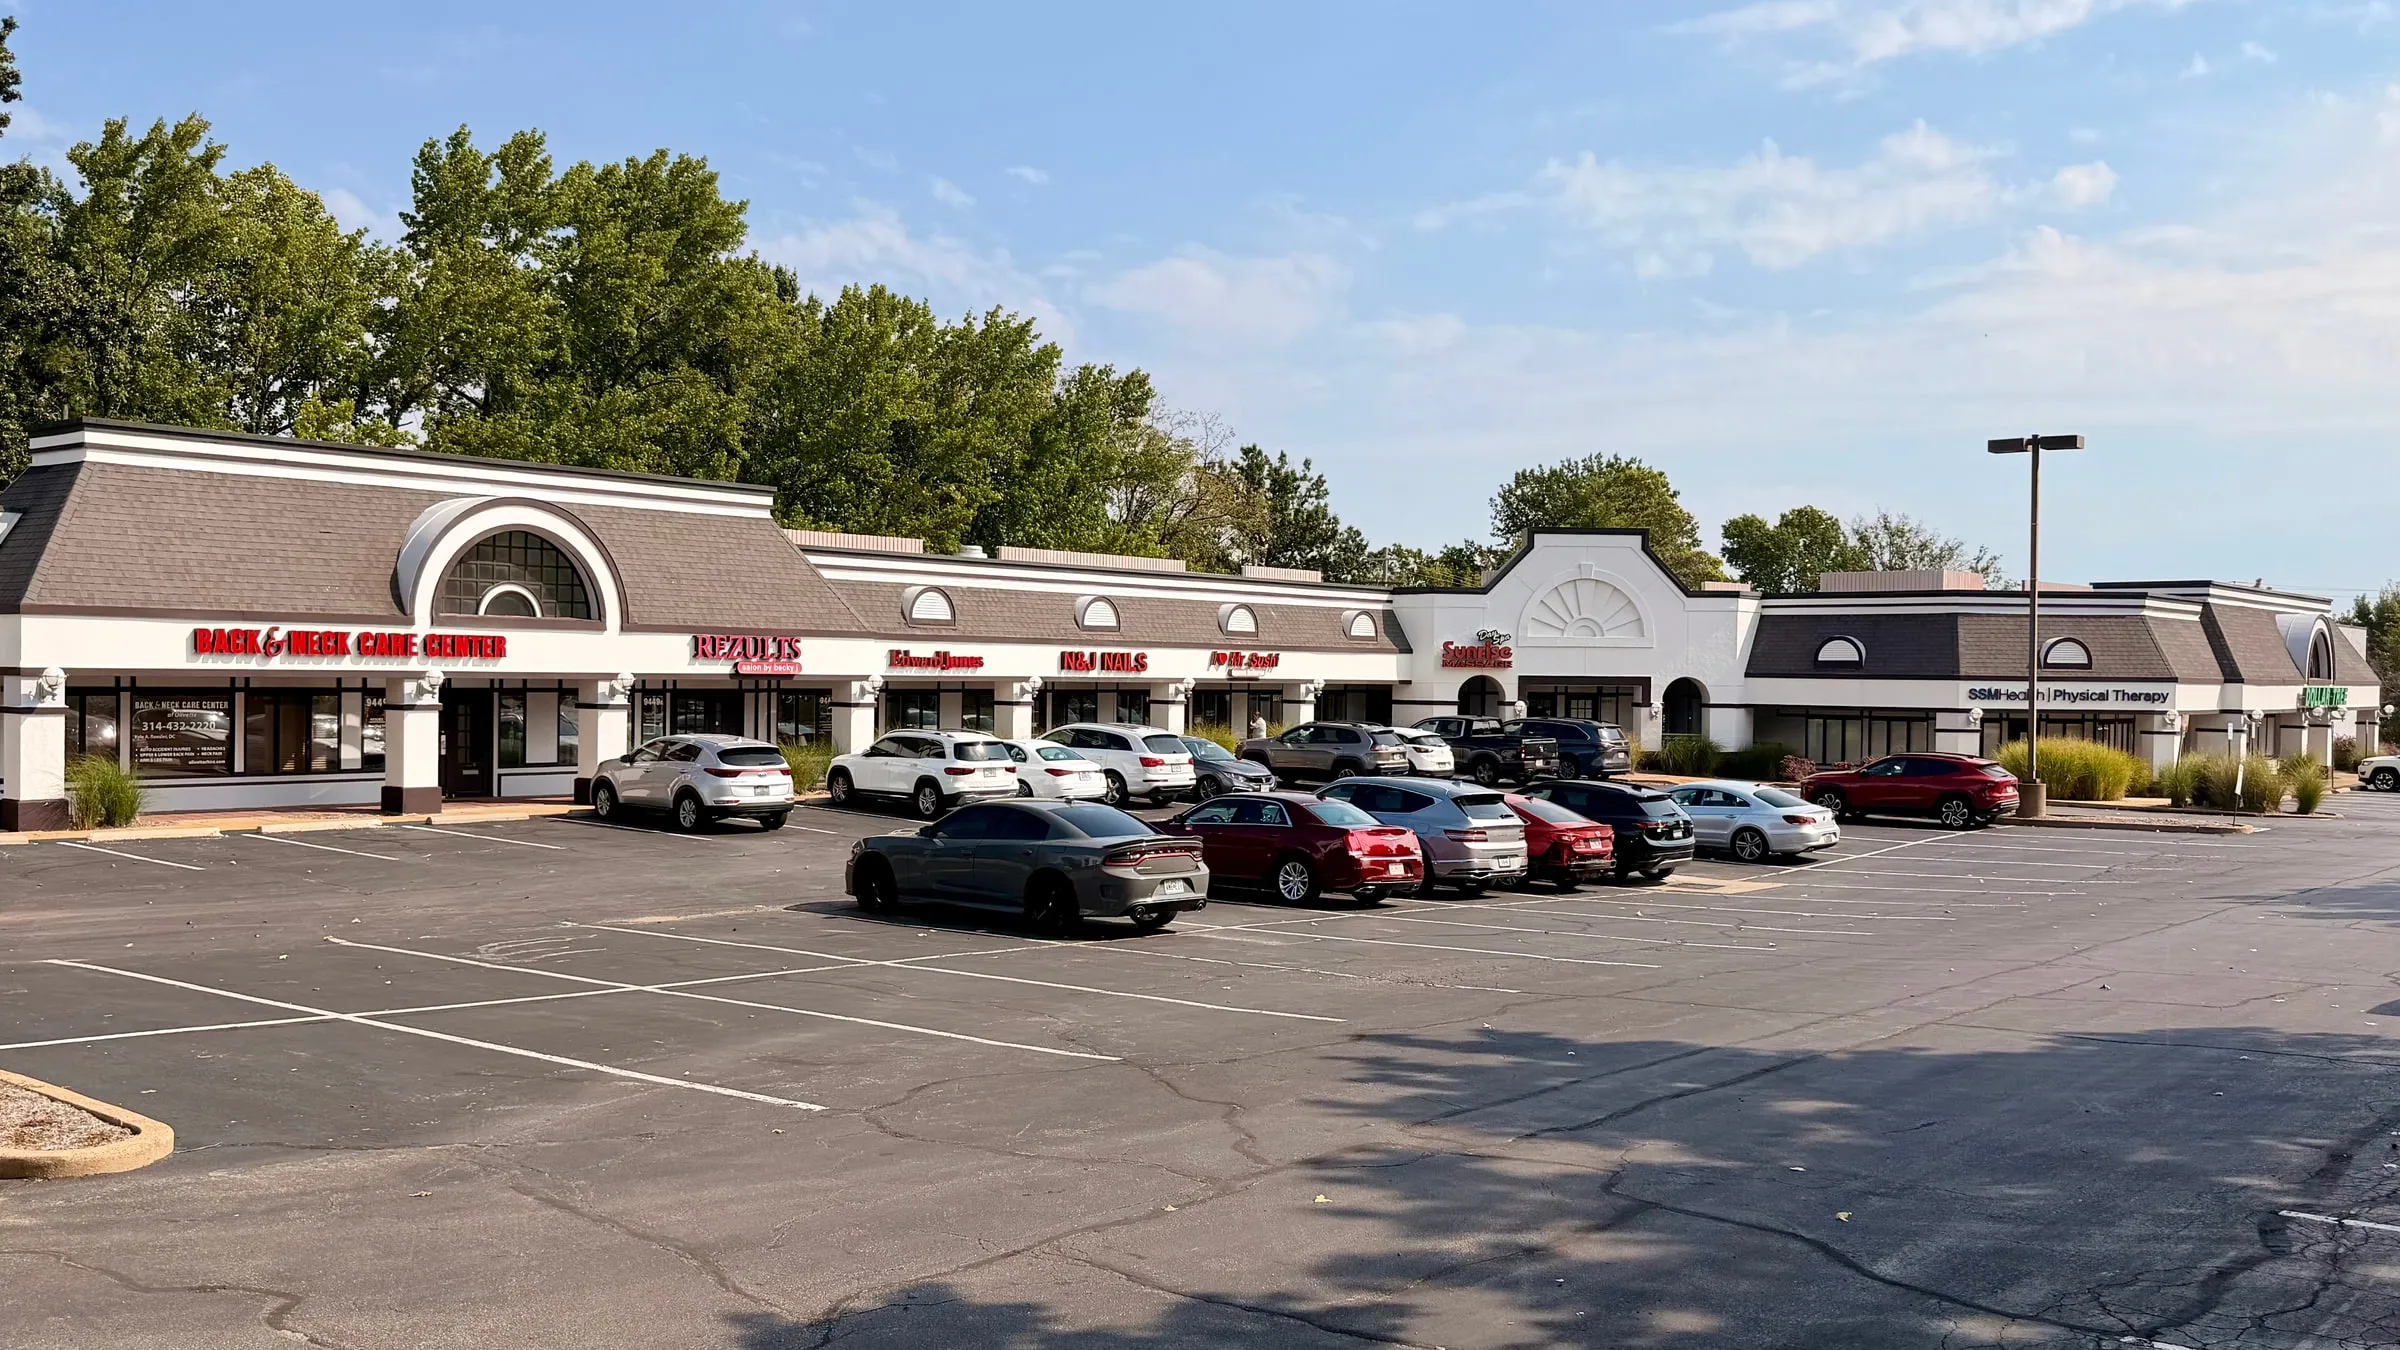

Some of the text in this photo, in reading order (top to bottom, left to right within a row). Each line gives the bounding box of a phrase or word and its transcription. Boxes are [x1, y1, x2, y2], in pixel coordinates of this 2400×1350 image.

[194, 626, 506, 658] BACK & NECK CARE CENTER
[1477, 630, 1512, 645] Day Spa
[693, 634, 802, 660] REZULTS
[1442, 641, 1513, 660] Sunrise
[1061, 651, 1148, 672] N&J NAILS
[1248, 653, 1280, 667] Sushi
[1442, 660, 1513, 669] MASSAGE
[764, 664, 772, 673] by
[774, 664, 794, 673] becky
[2053, 688, 2110, 703] Physical
[2112, 689, 2169, 703] Therapy
[2303, 687, 2332, 708] DOLLAR
[135, 701, 154, 709] BACK
[161, 701, 180, 709] NECK
[182, 701, 200, 709] CARE
[202, 701, 229, 709] CENTER
[142, 721, 216, 731] 314-432-2220
